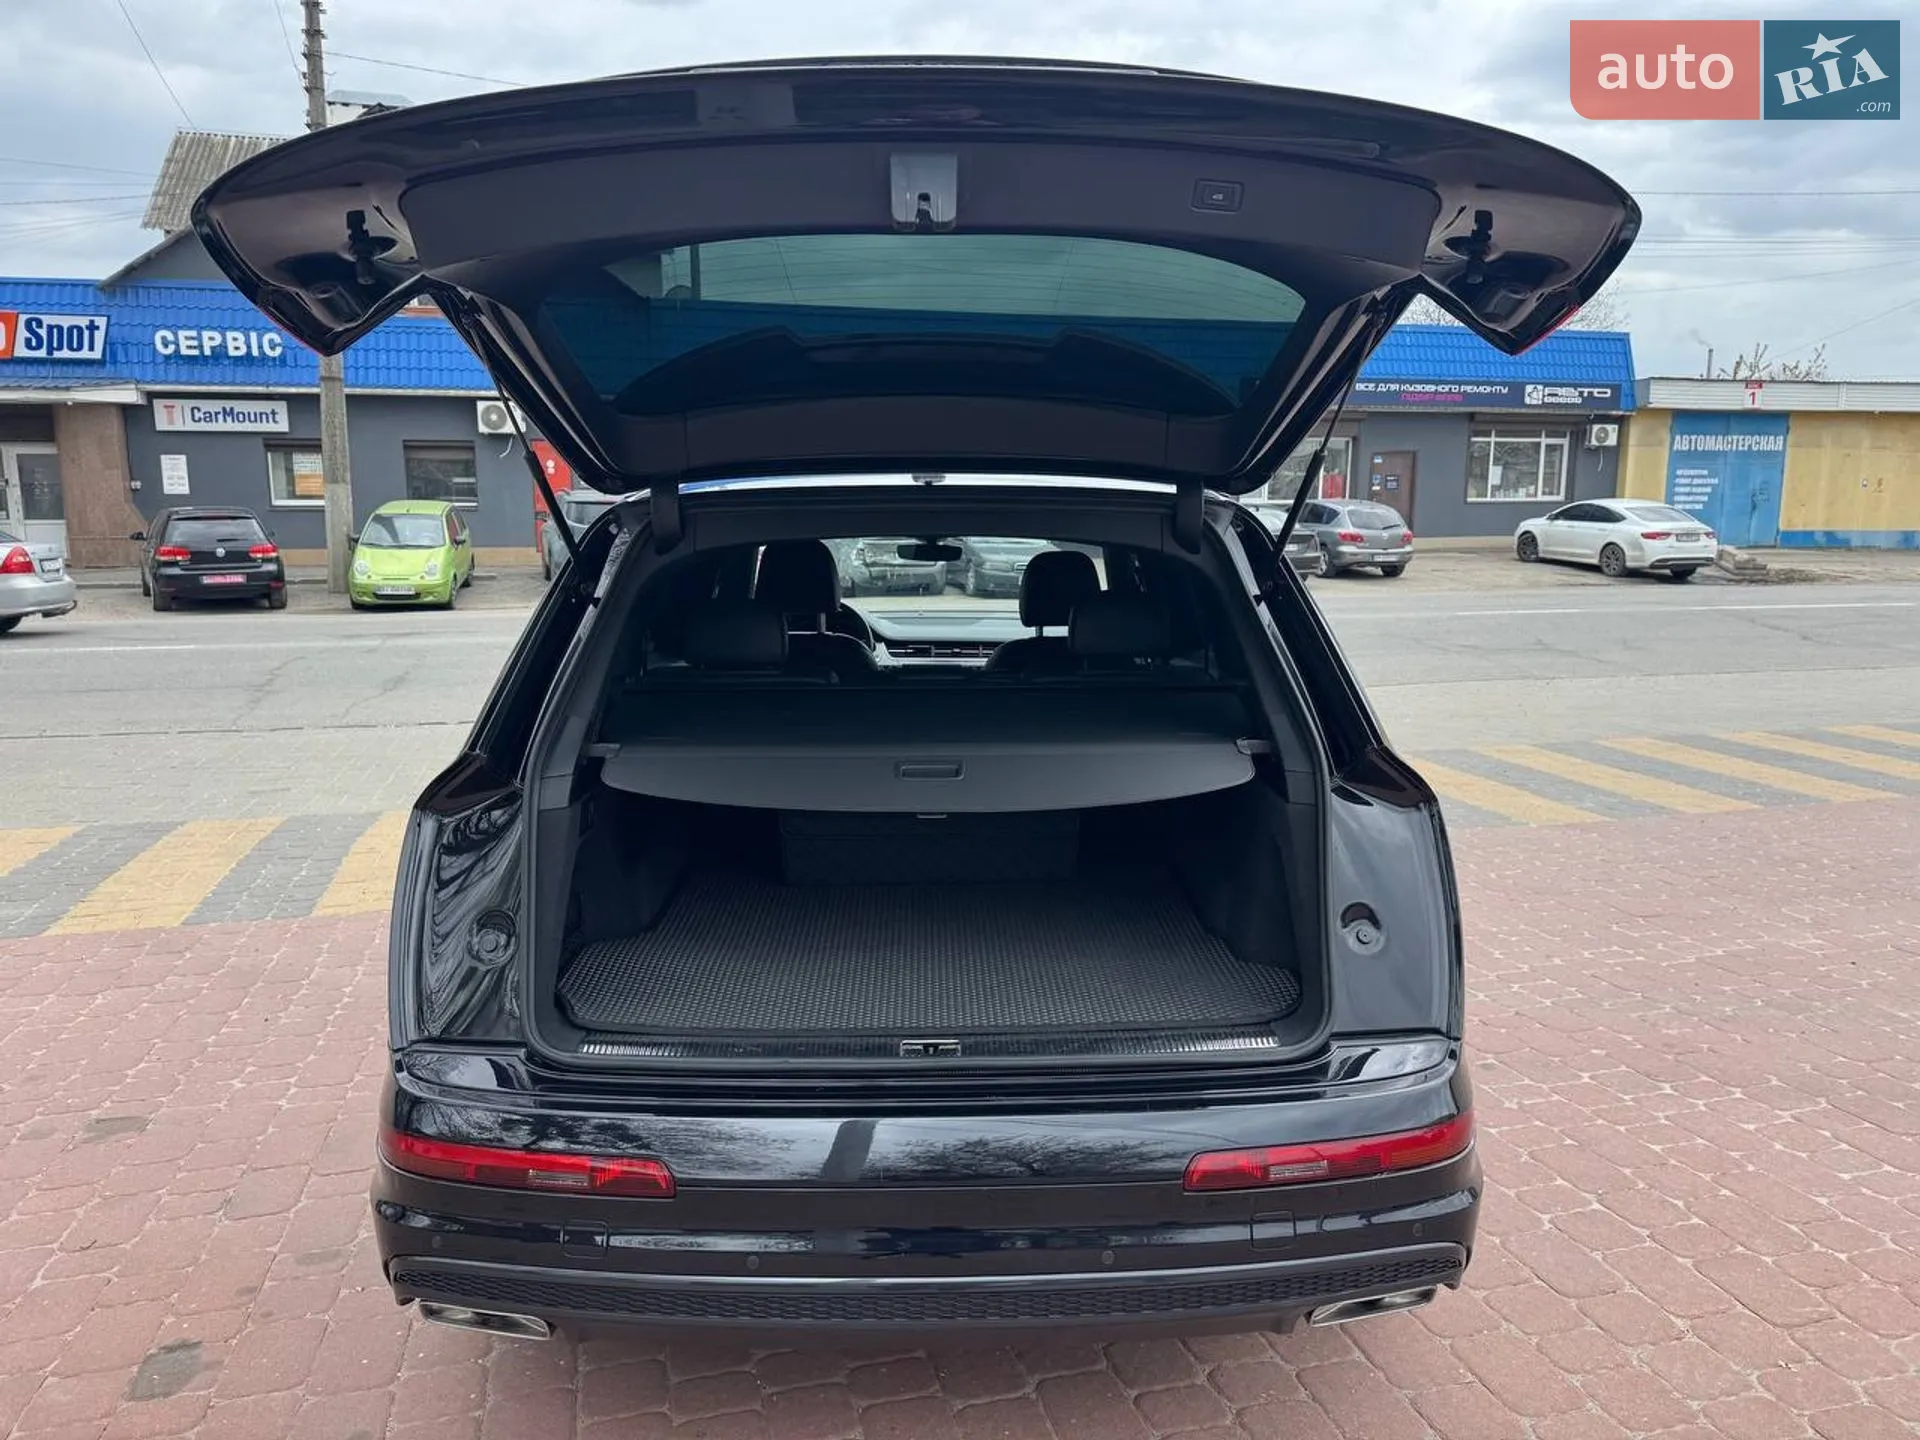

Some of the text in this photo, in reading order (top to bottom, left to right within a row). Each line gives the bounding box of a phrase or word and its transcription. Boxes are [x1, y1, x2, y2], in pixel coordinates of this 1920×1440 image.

[24, 317, 100, 356] Spot
[154, 329, 283, 358] СЕРВІС
[1377, 383, 1399, 392] ДЛЯ
[1749, 391, 1756, 406] 1
[191, 406, 280, 425] CarMount
[1673, 434, 1784, 452] АВТОМАСТЕРСКАЯ
